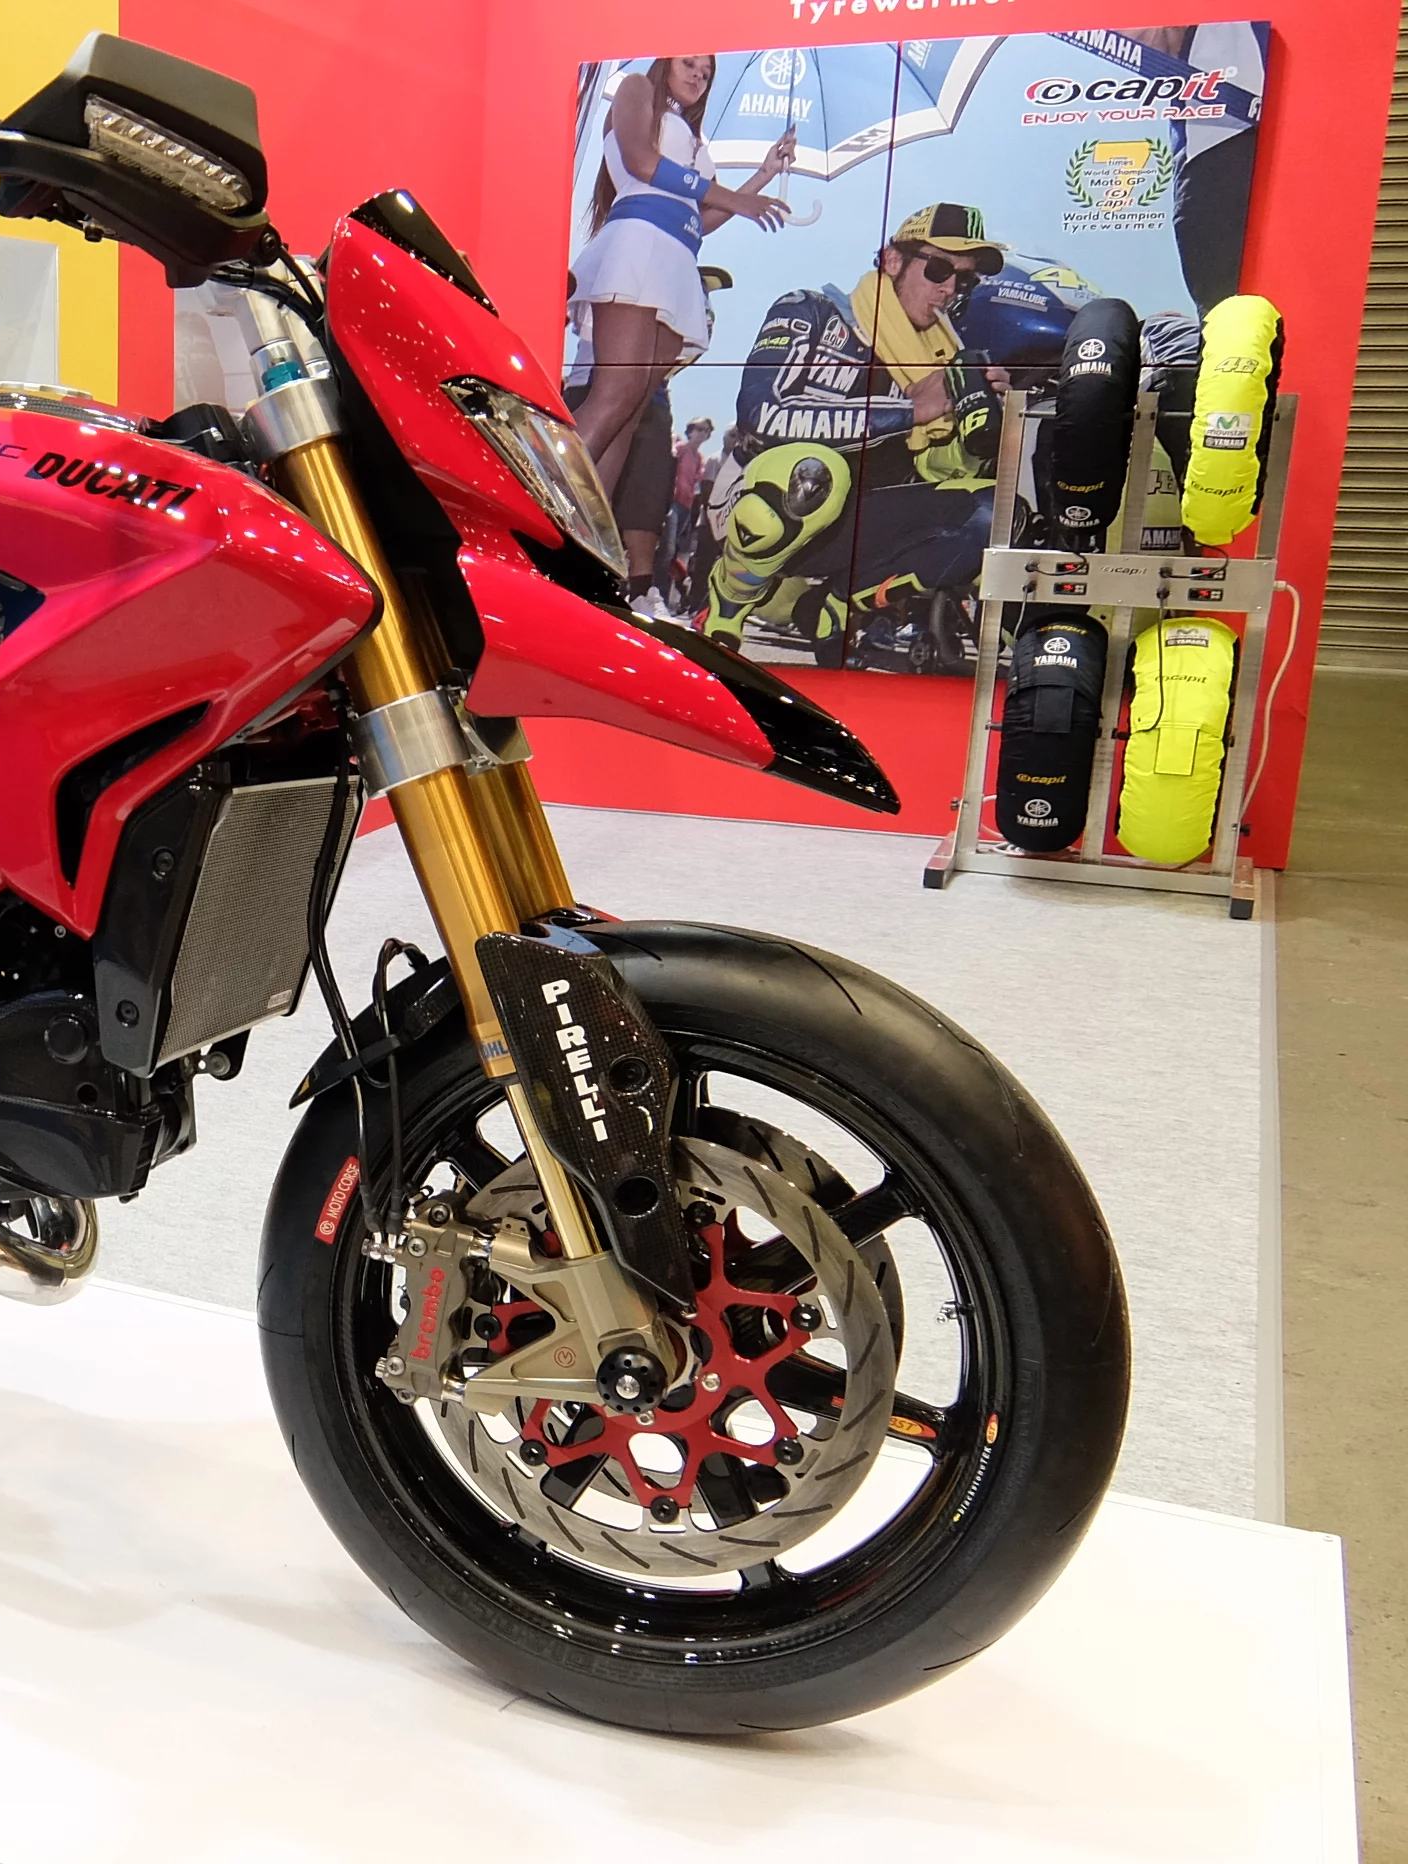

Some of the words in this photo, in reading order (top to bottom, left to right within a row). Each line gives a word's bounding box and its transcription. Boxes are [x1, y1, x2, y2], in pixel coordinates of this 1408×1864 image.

[1022, 110, 1089, 125] ENJOY
[1097, 108, 1156, 122] YOUR
[1161, 104, 1227, 118] RACE
[1090, 178, 1122, 188] Moto
[1126, 177, 1146, 186] GP
[1063, 211, 1100, 222] World
[1103, 211, 1165, 222] Champion
[1062, 221, 1164, 234] Tyrewarmer
[1069, 361, 1112, 376] YAMAHA
[756, 402, 870, 439] YAMAHA
[33, 451, 198, 518] DUCATI
[1059, 515, 1100, 528] YAMAHA
[1033, 654, 1078, 669] YAMAHA
[1016, 814, 1059, 828] YAMAHA
[541, 979, 609, 1142] PIRELLI
[326, 1191, 347, 1219] MOTO
[409, 1267, 445, 1360] brembo
